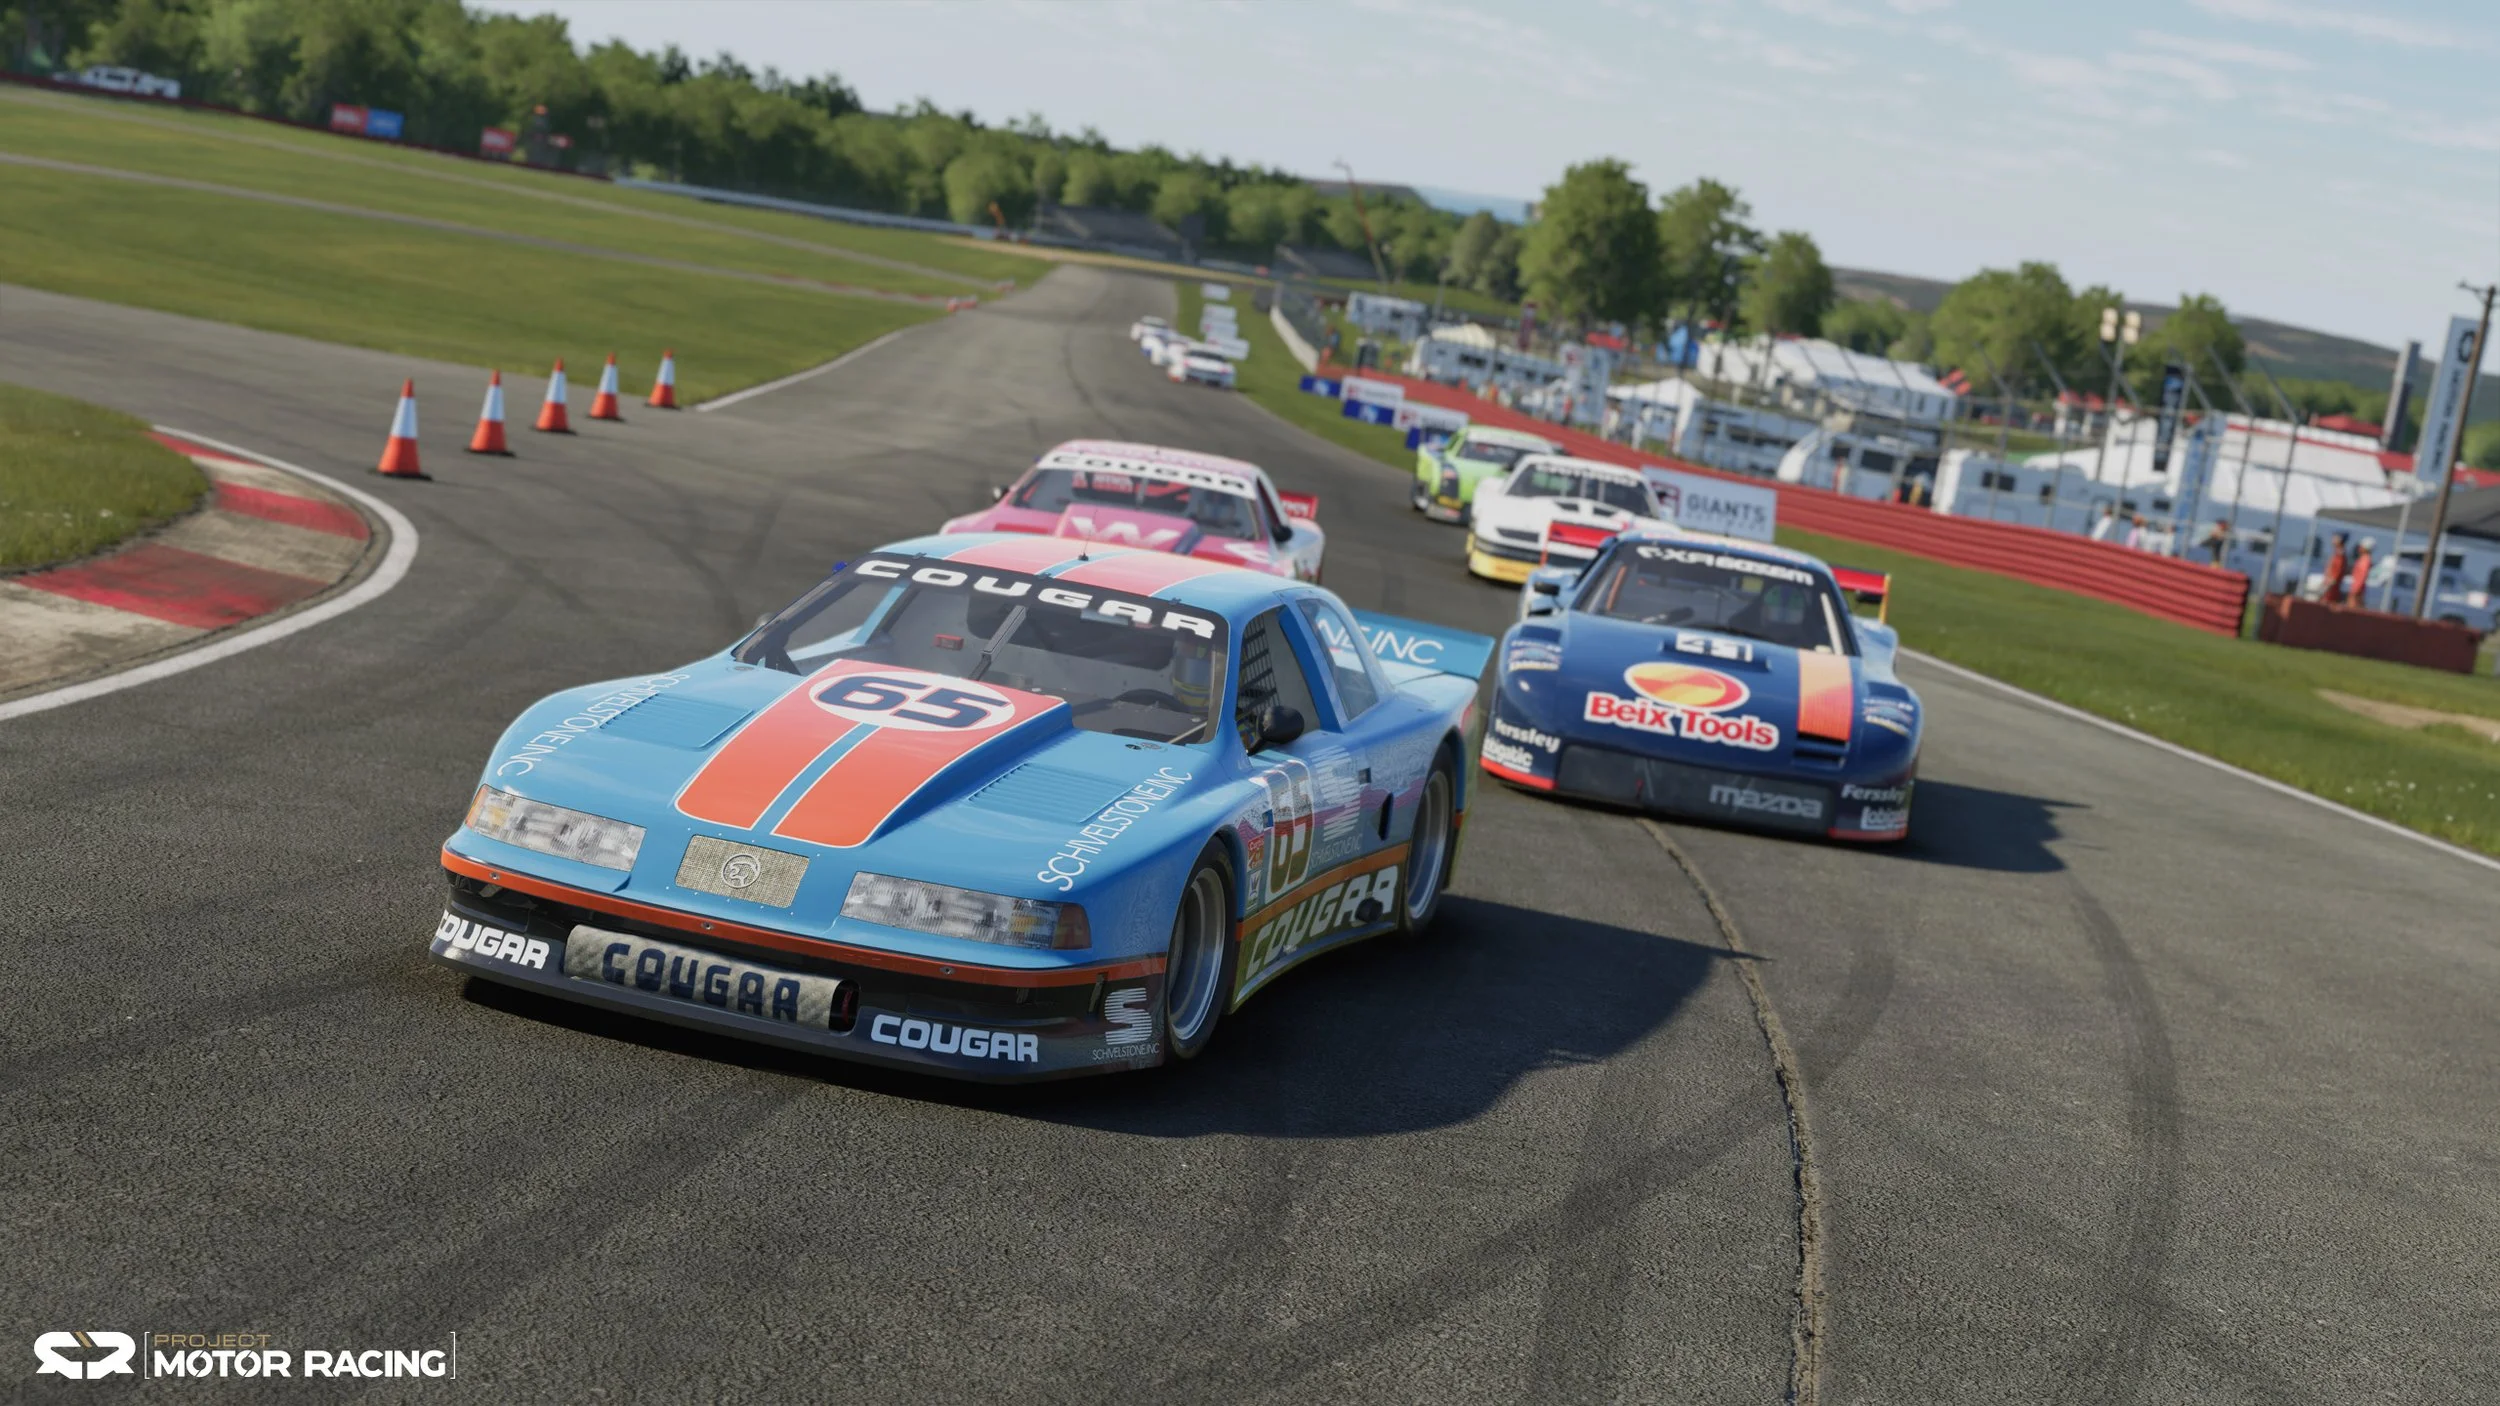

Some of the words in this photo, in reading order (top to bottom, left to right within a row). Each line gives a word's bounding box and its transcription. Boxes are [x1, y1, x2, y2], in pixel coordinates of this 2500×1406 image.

[1687, 494, 1766, 525] GIANTS
[855, 560, 1215, 639] COUGAR
[815, 675, 1012, 730] 65
[1588, 693, 1672, 732] Beix
[1681, 706, 1776, 748] Tools
[1245, 865, 1398, 980] COUGAR
[602, 942, 801, 1023] COUGAR
[871, 1014, 1039, 1063] COUGAR
